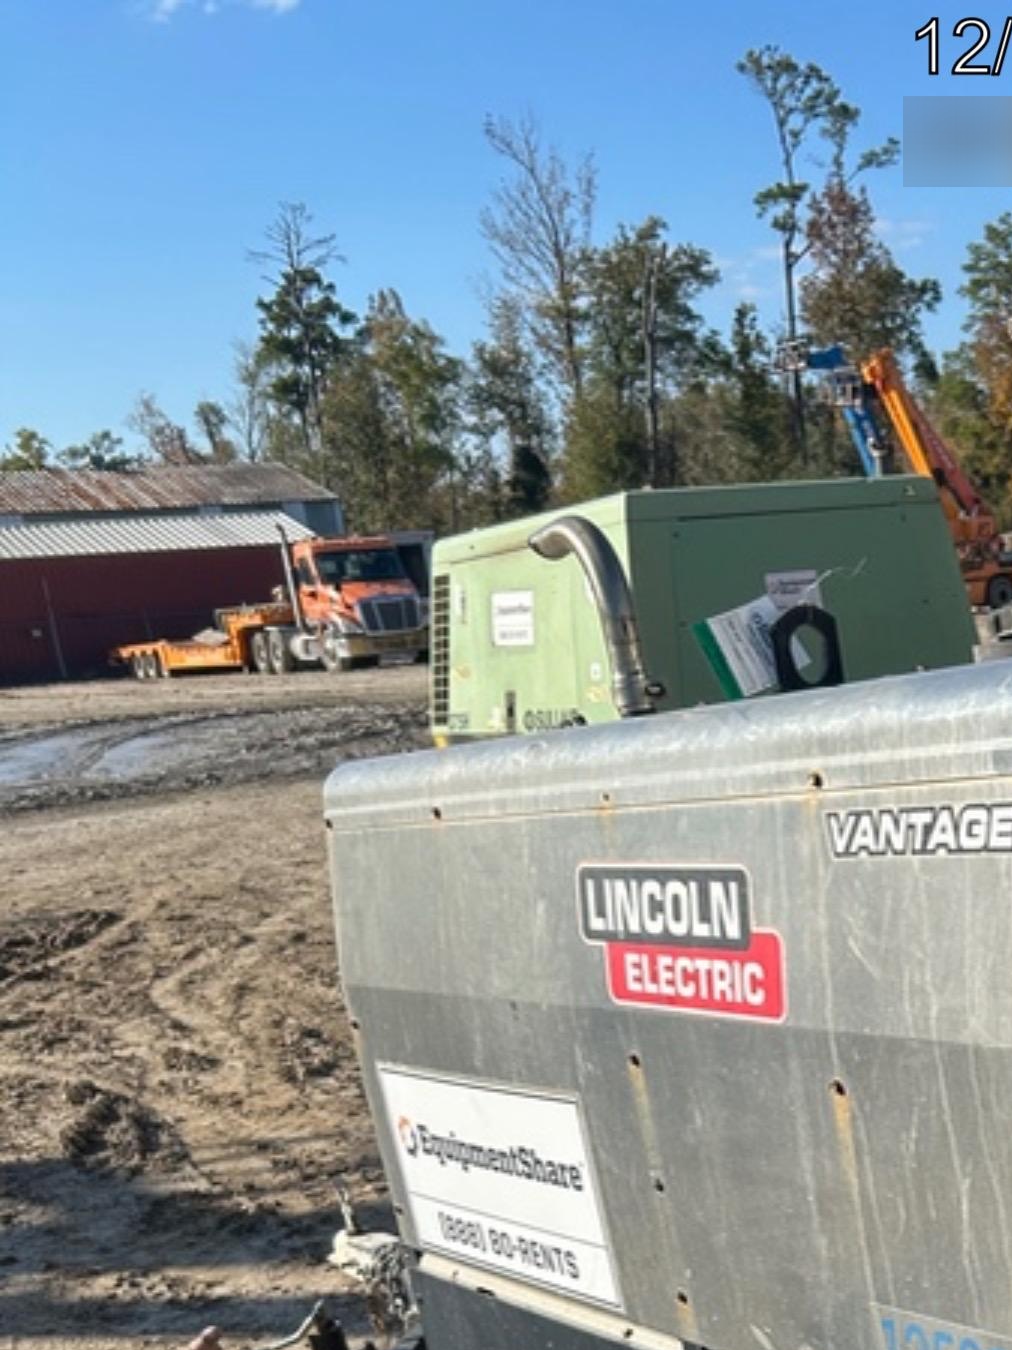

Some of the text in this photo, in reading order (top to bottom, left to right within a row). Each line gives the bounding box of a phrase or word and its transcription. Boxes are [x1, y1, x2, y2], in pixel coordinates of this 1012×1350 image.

[584, 877, 743, 939] LINCOLN
[624, 953, 766, 1005] ELECTRIC
[416, 1123, 584, 1192] EquipmentShare
[488, 1228, 581, 1279] 80-RENTS
